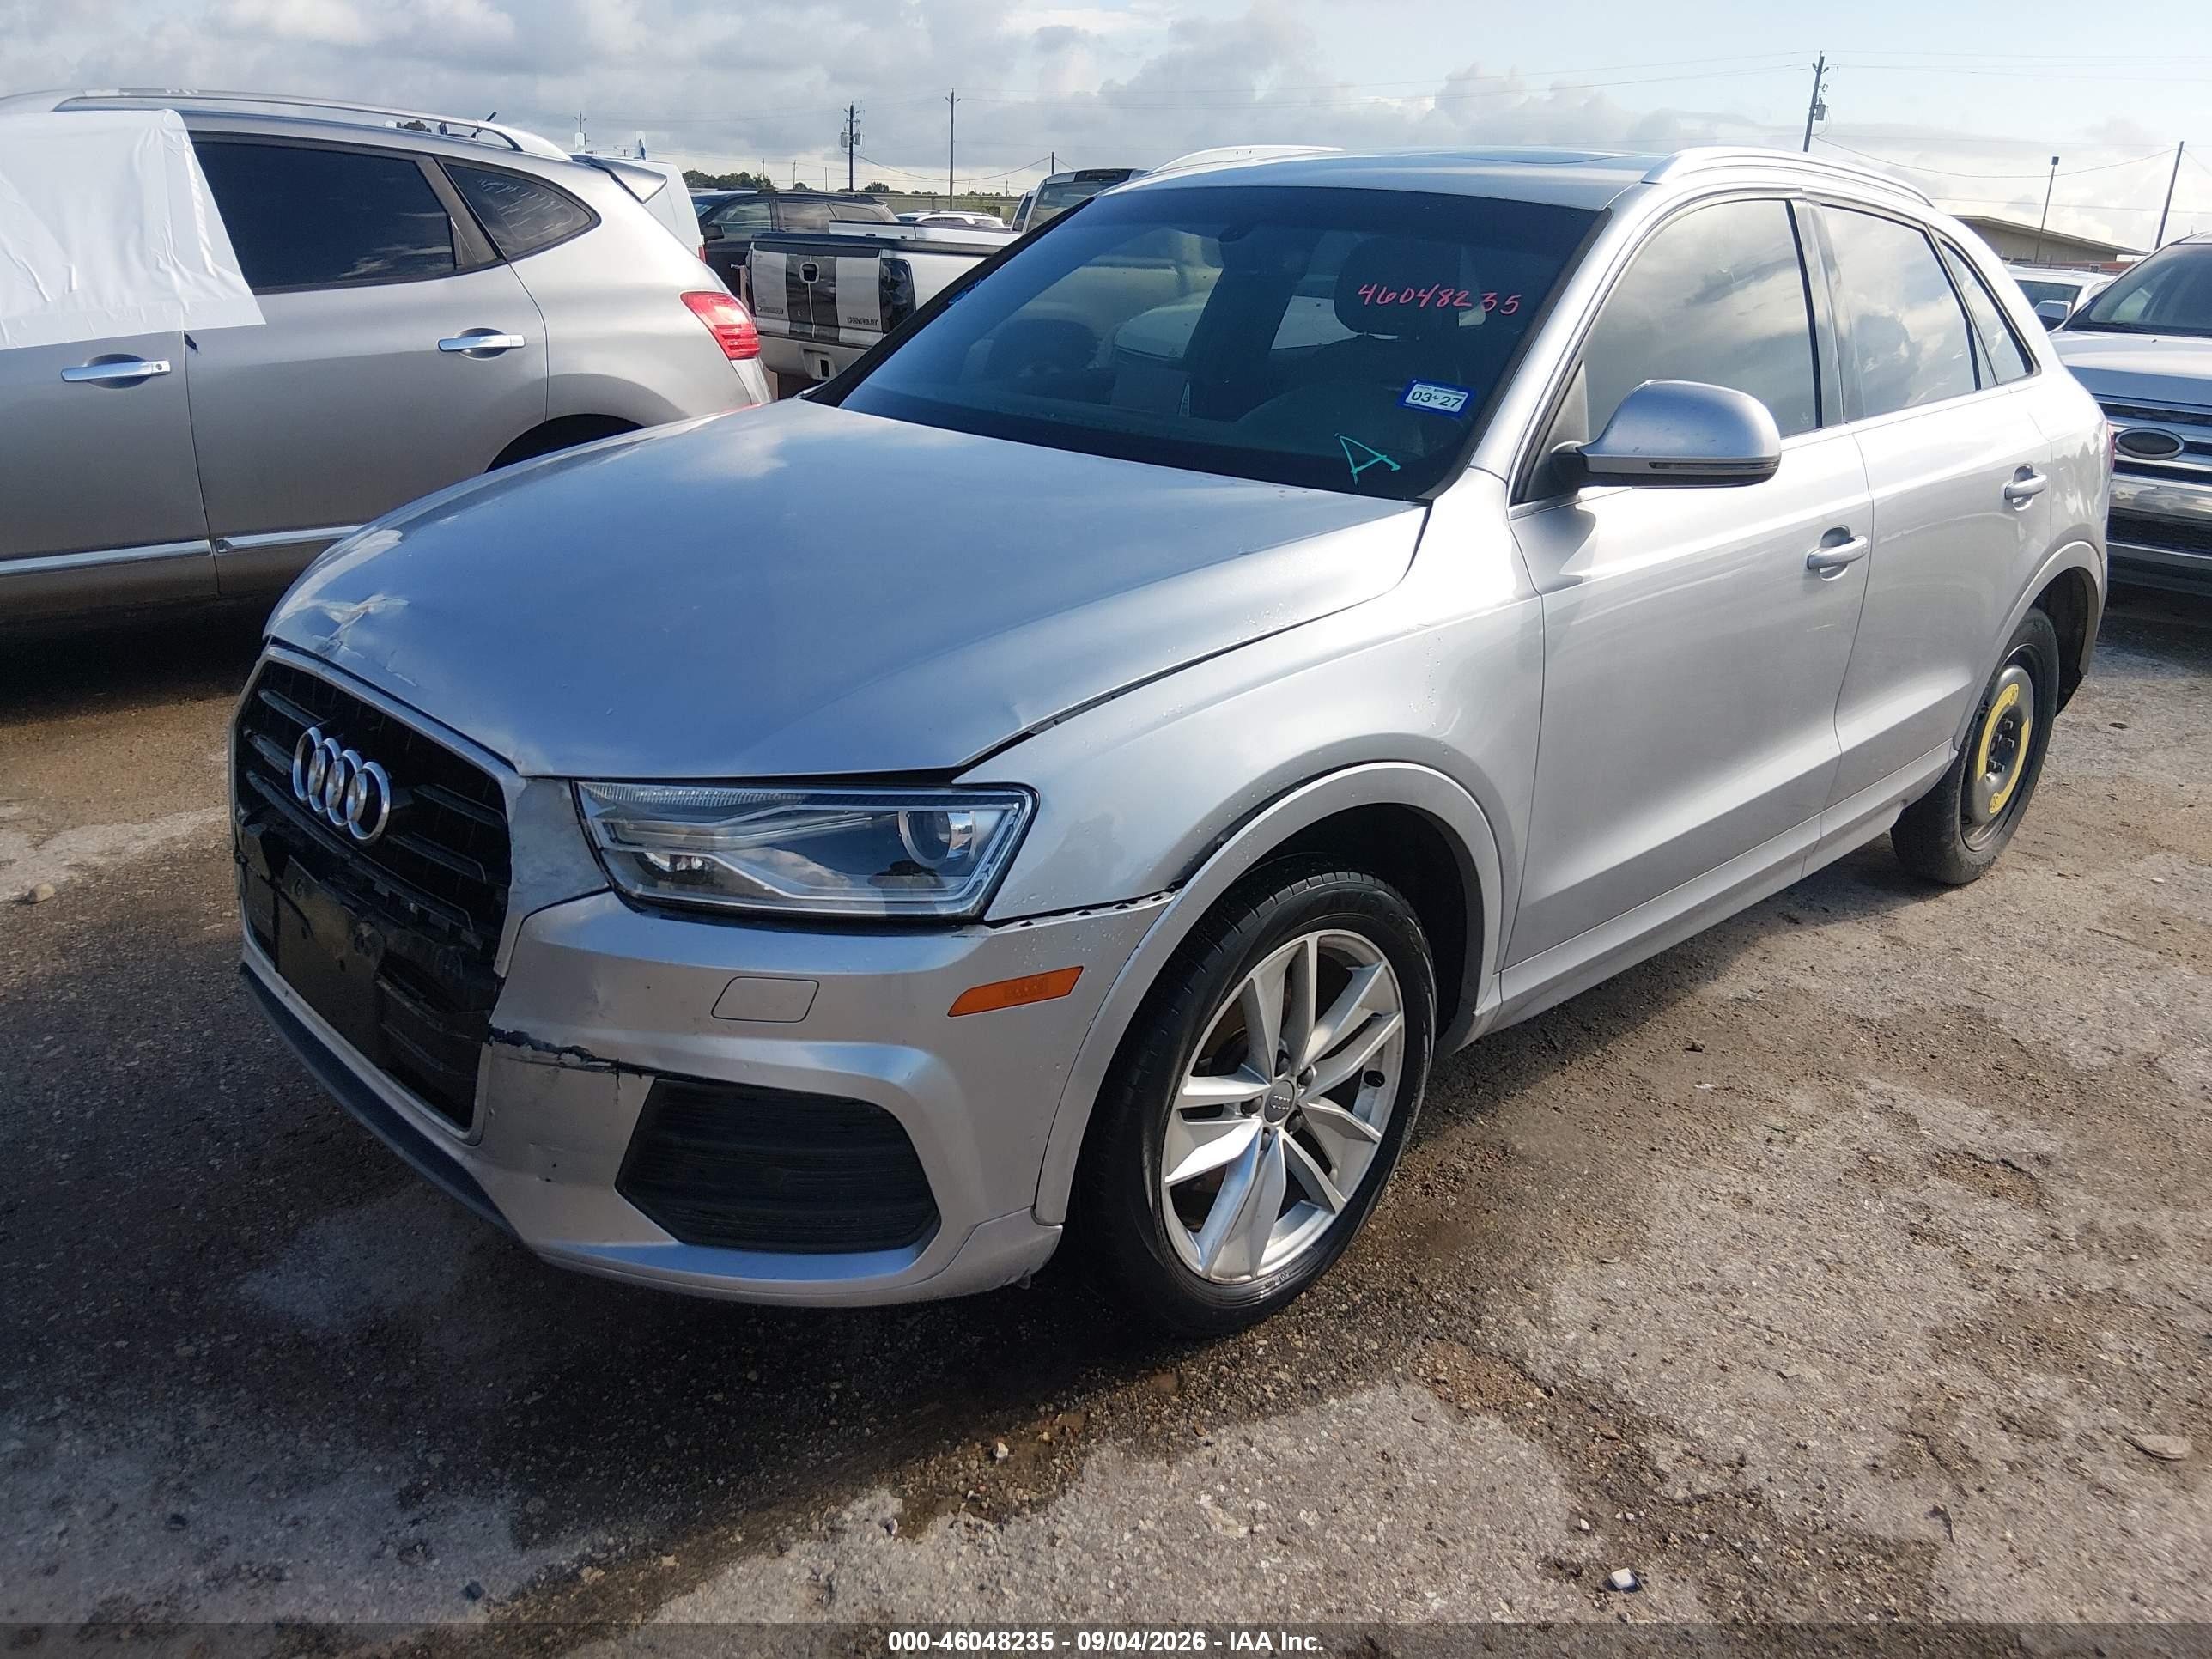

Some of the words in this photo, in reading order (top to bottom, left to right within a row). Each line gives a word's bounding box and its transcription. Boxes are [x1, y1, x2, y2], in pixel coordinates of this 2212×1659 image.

[1358, 283, 1522, 315] 46048235
[1411, 391, 1433, 403] 03
[1438, 396, 1463, 408] 27
